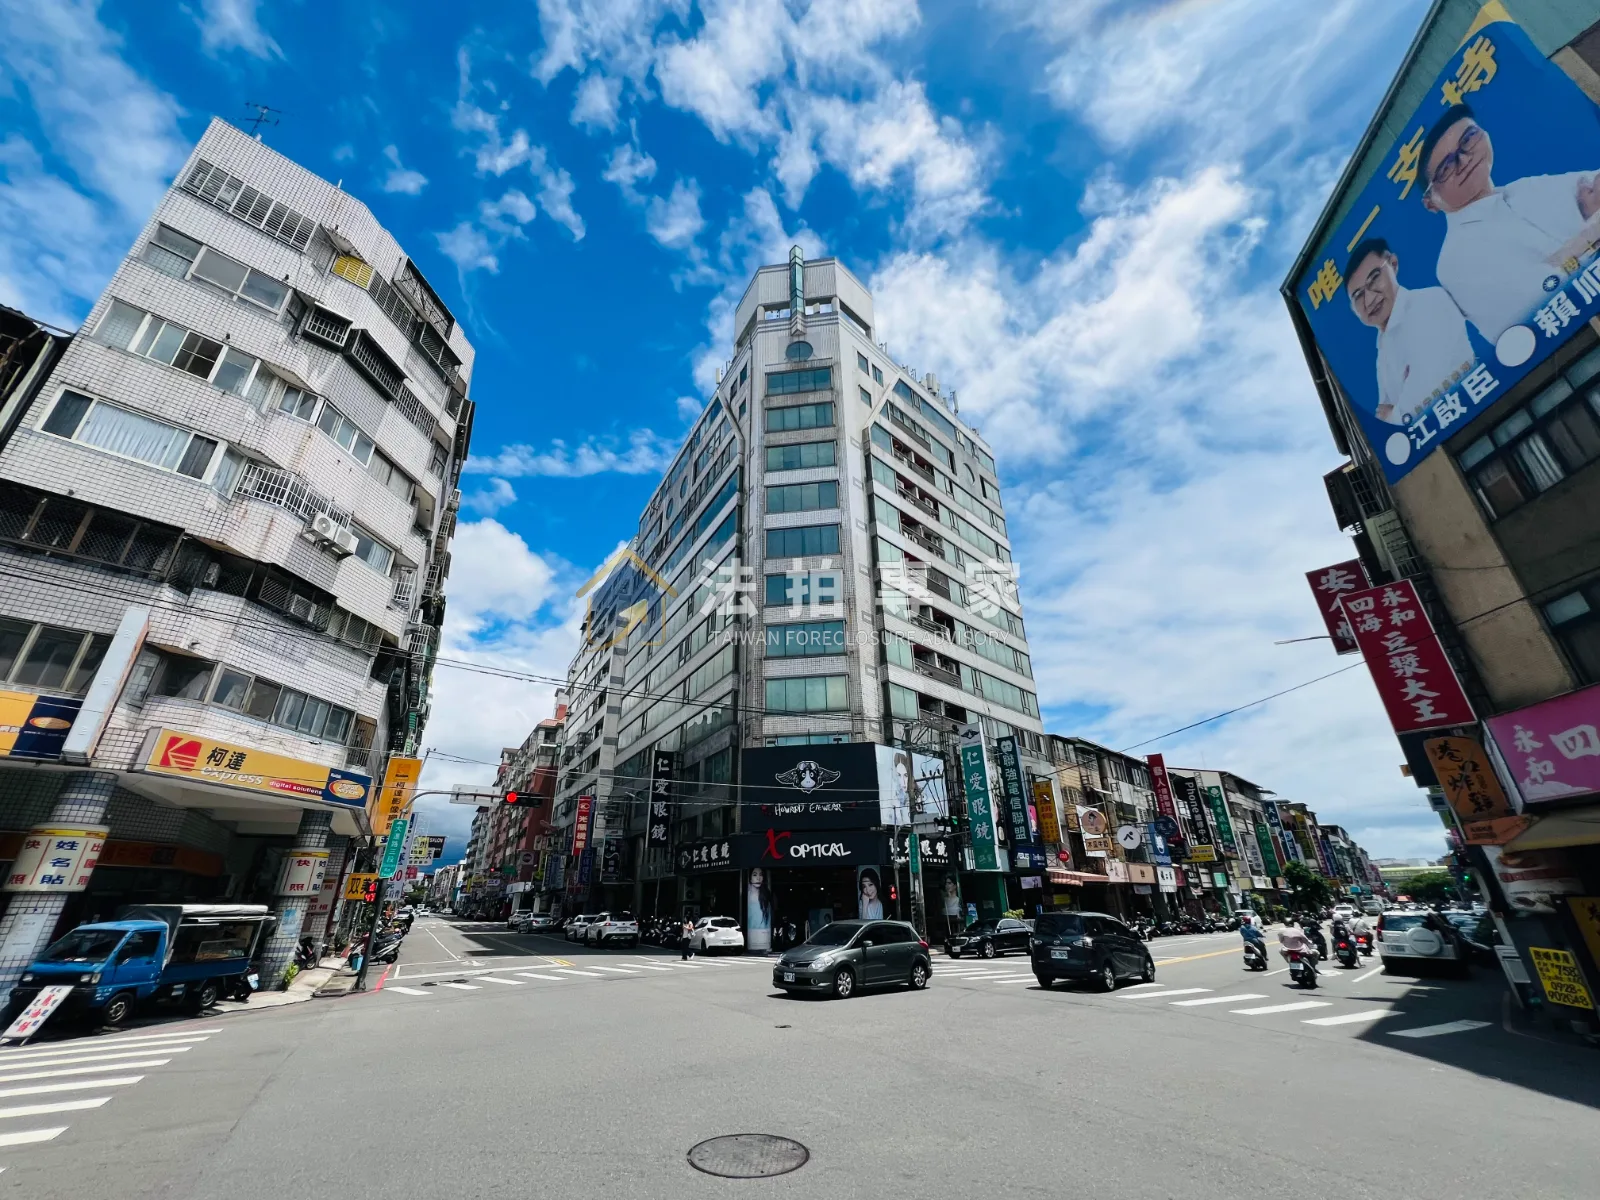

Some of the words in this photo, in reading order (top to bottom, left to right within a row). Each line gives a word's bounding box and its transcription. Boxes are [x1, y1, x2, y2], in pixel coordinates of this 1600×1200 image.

[1347, 597, 1384, 633] 四海
[1381, 587, 1416, 627] 永和
[206, 746, 248, 771] 柯達
[1513, 725, 1556, 784] 永和
[200, 765, 264, 786] express
[269, 780, 292, 790] digital
[966, 751, 992, 840] 仁愛眼鏡
[651, 757, 669, 841] 仁愛眼鏡
[1002, 754, 1027, 840] 聯強電信聯盟
[40, 840, 79, 885] 姓名貼
[790, 843, 852, 858] OPTICAL
